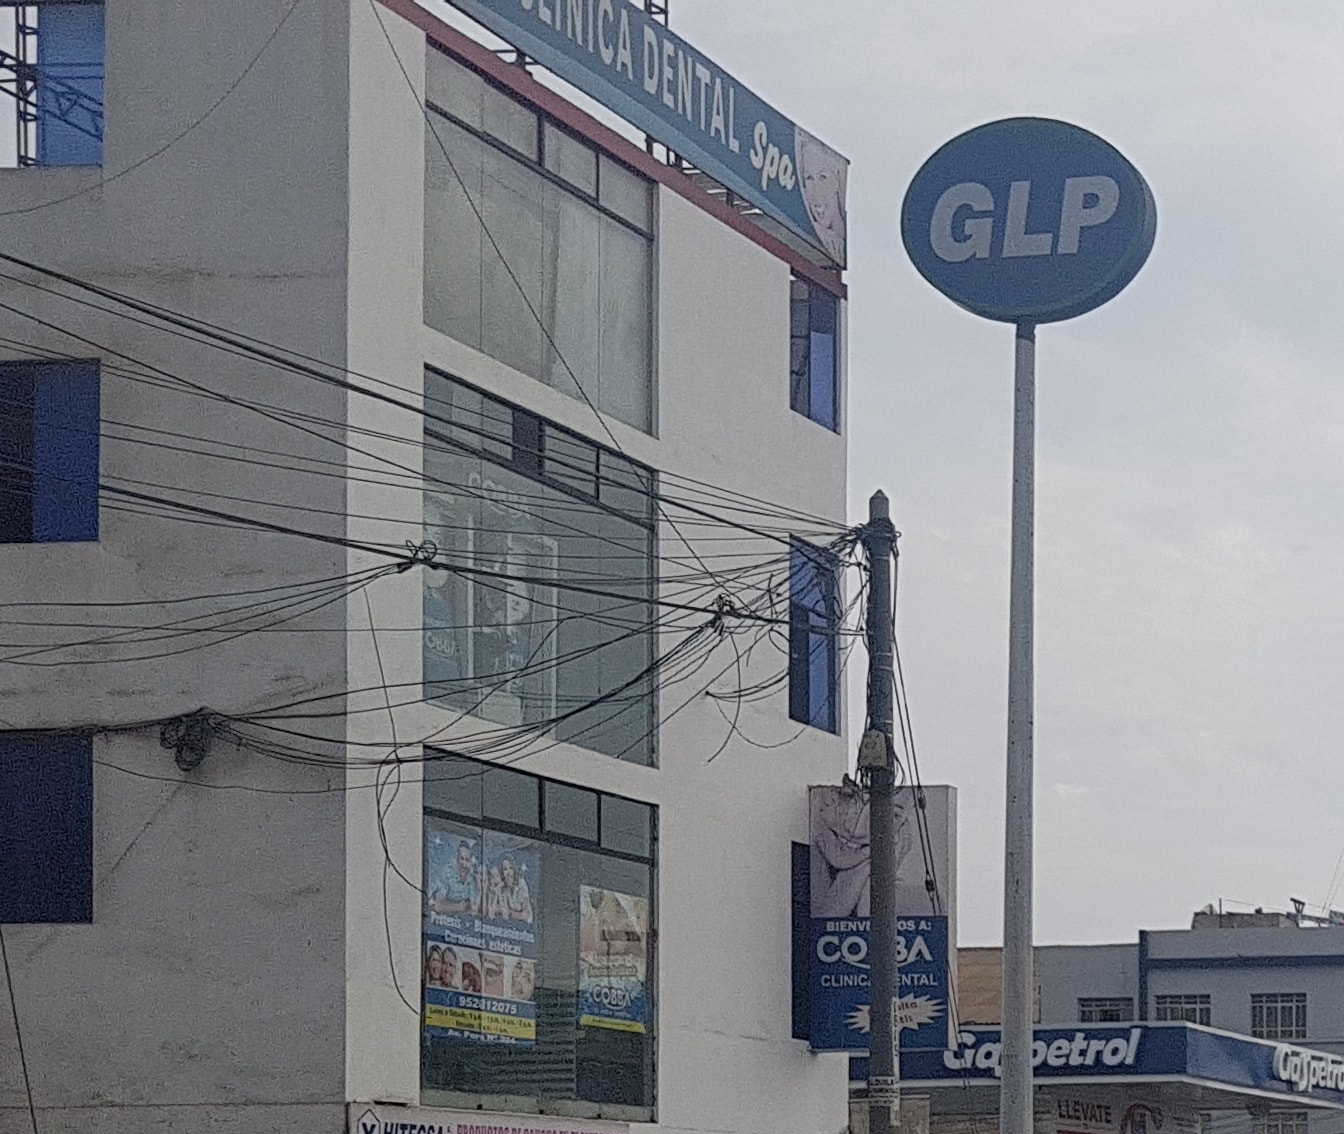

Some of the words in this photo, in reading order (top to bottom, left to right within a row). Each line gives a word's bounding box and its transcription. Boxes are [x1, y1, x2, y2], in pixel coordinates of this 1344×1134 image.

[520, 0, 634, 81] INICA
[643, 24, 741, 154] DENTAL
[749, 120, 797, 192] Spa
[929, 175, 1121, 264] GLP
[826, 920, 915, 932] BIENVOS
[816, 935, 933, 964] COBA
[820, 973, 871, 987] CLINIC
[943, 1029, 1142, 1078] Gapetrol
